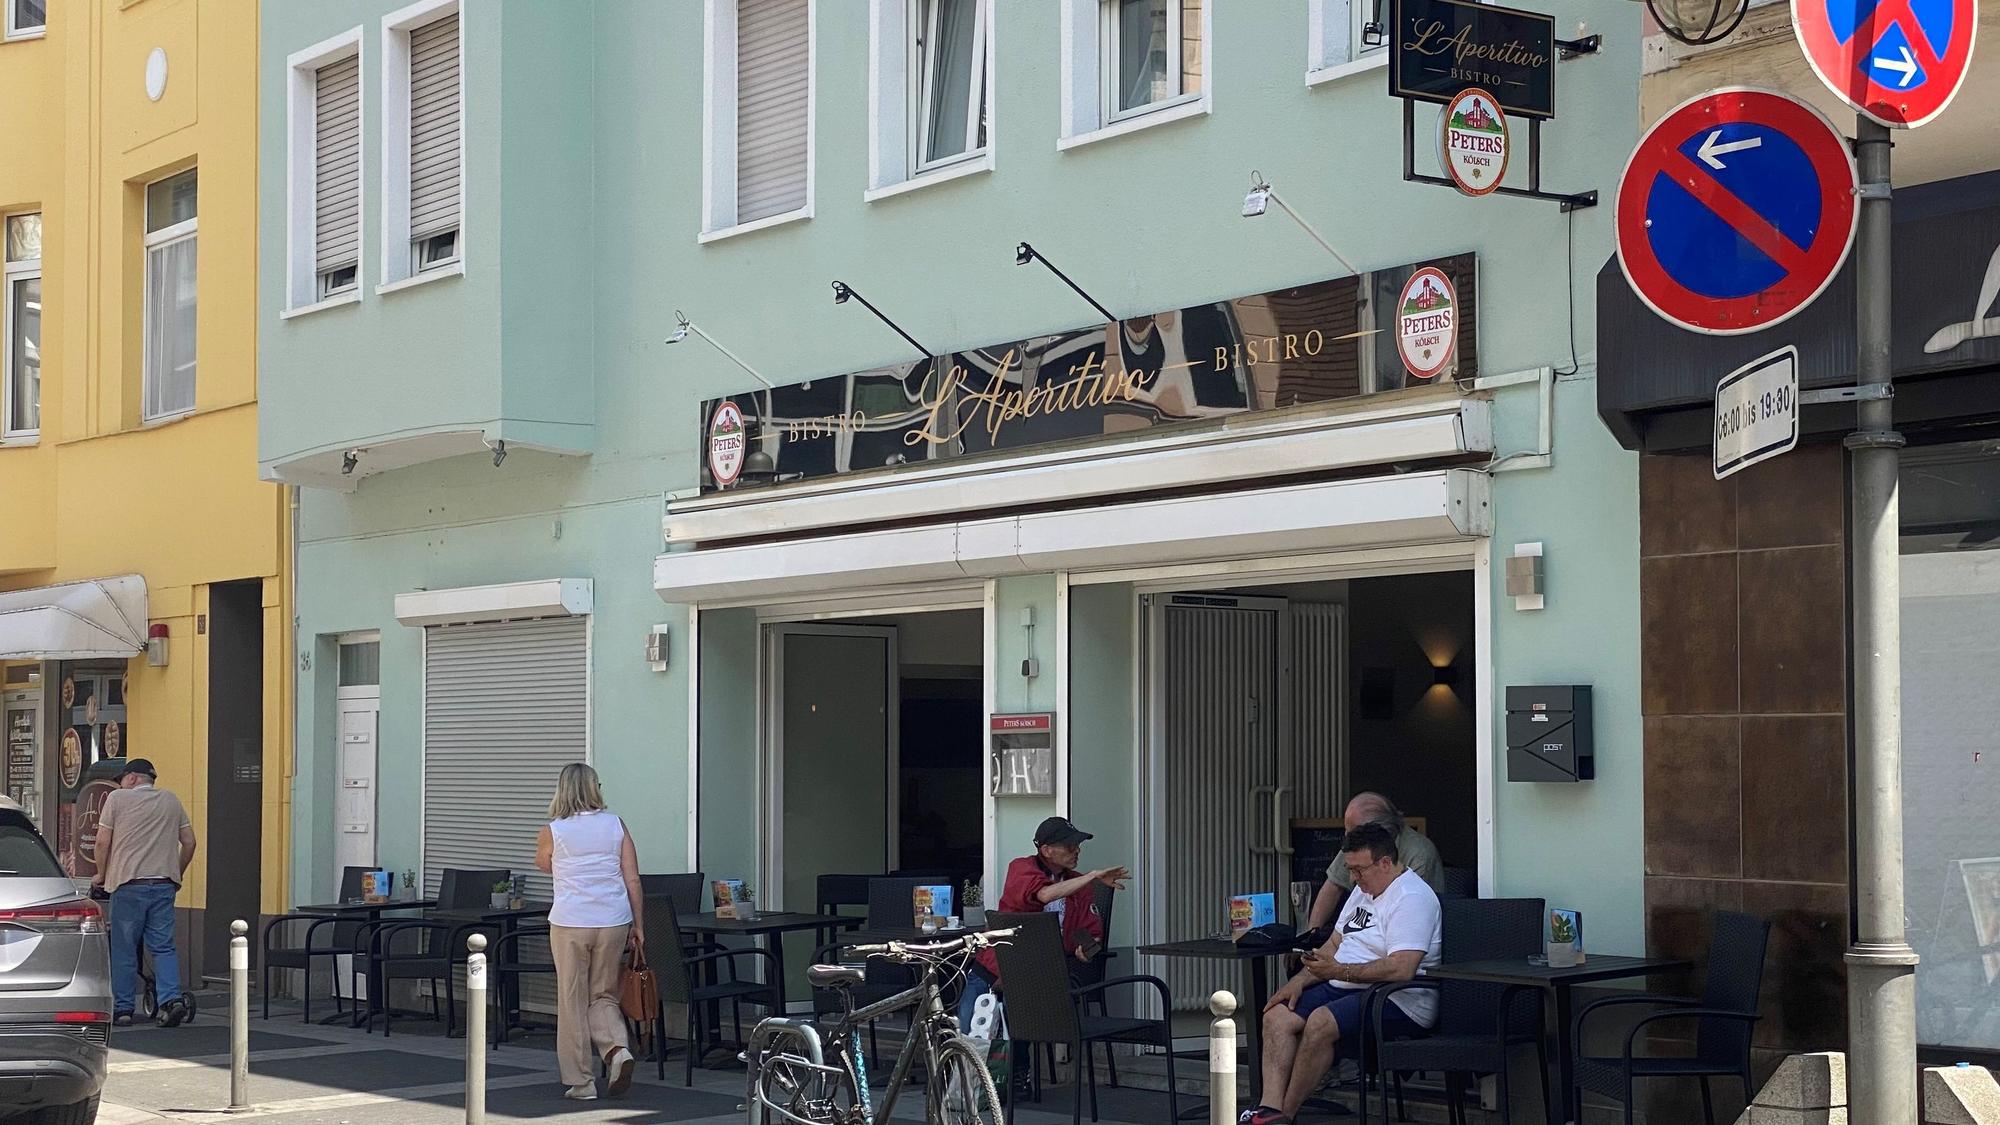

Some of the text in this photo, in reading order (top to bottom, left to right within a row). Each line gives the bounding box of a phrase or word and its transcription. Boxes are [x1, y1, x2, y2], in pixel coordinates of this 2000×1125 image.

[1403, 18, 1549, 68] L'Aperitivo
[1451, 67, 1501, 86] BISTRO
[1450, 129, 1503, 154] PETERS
[1463, 154, 1490, 167] KÖLSCH
[1403, 310, 1451, 336] PETERS
[1414, 335, 1440, 348] KÖLSCH
[789, 329, 1323, 447] BISTRO L'Aperitivo BISTRO
[1743, 400, 1756, 429] bis
[1760, 385, 1790, 420] 19:30
[714, 435, 741, 452] PETERS
[1350, 906, 1373, 928] NIKE
